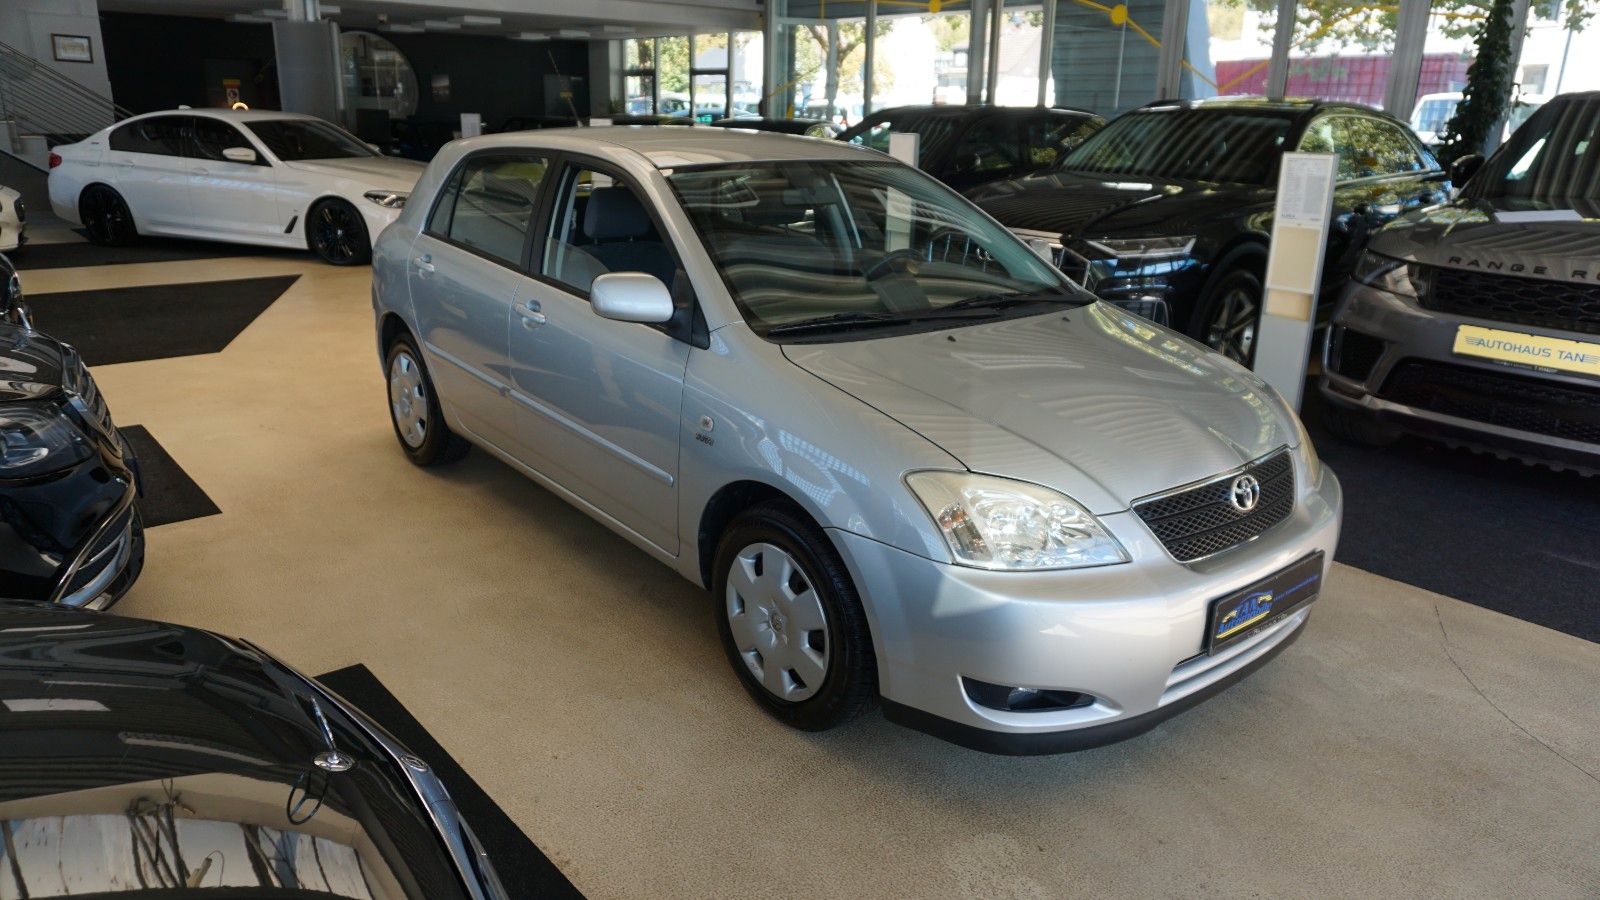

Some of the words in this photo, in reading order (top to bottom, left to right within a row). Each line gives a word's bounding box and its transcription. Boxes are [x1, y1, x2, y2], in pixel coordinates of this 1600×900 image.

[1448, 257, 1549, 274] RANGE
[1571, 270, 1600, 281] R
[1478, 338, 1552, 357] AUTOHAUS
[1557, 350, 1586, 363] TAN
